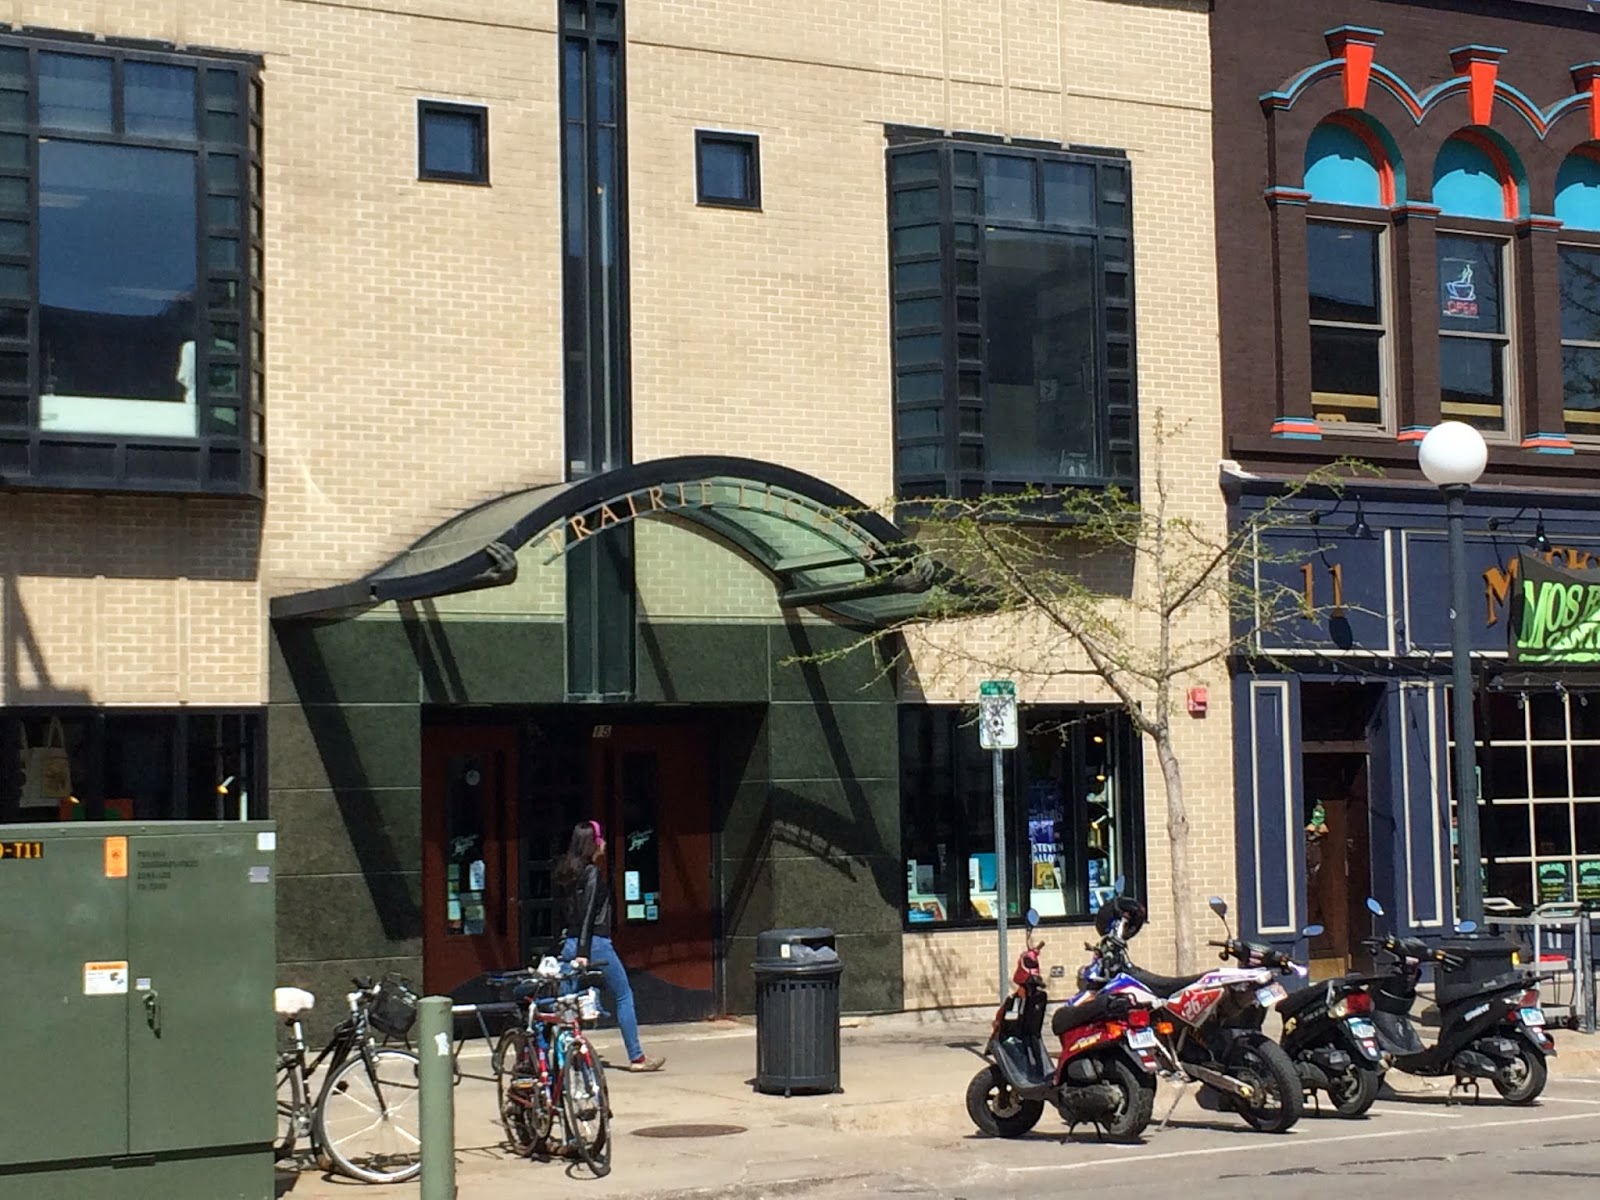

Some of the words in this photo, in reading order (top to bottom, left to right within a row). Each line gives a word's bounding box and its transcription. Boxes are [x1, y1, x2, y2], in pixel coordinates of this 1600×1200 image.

[548, 481, 714, 554] PRAIRIE
[1300, 562, 1342, 620] 11
[1517, 580, 1584, 649] MOS
